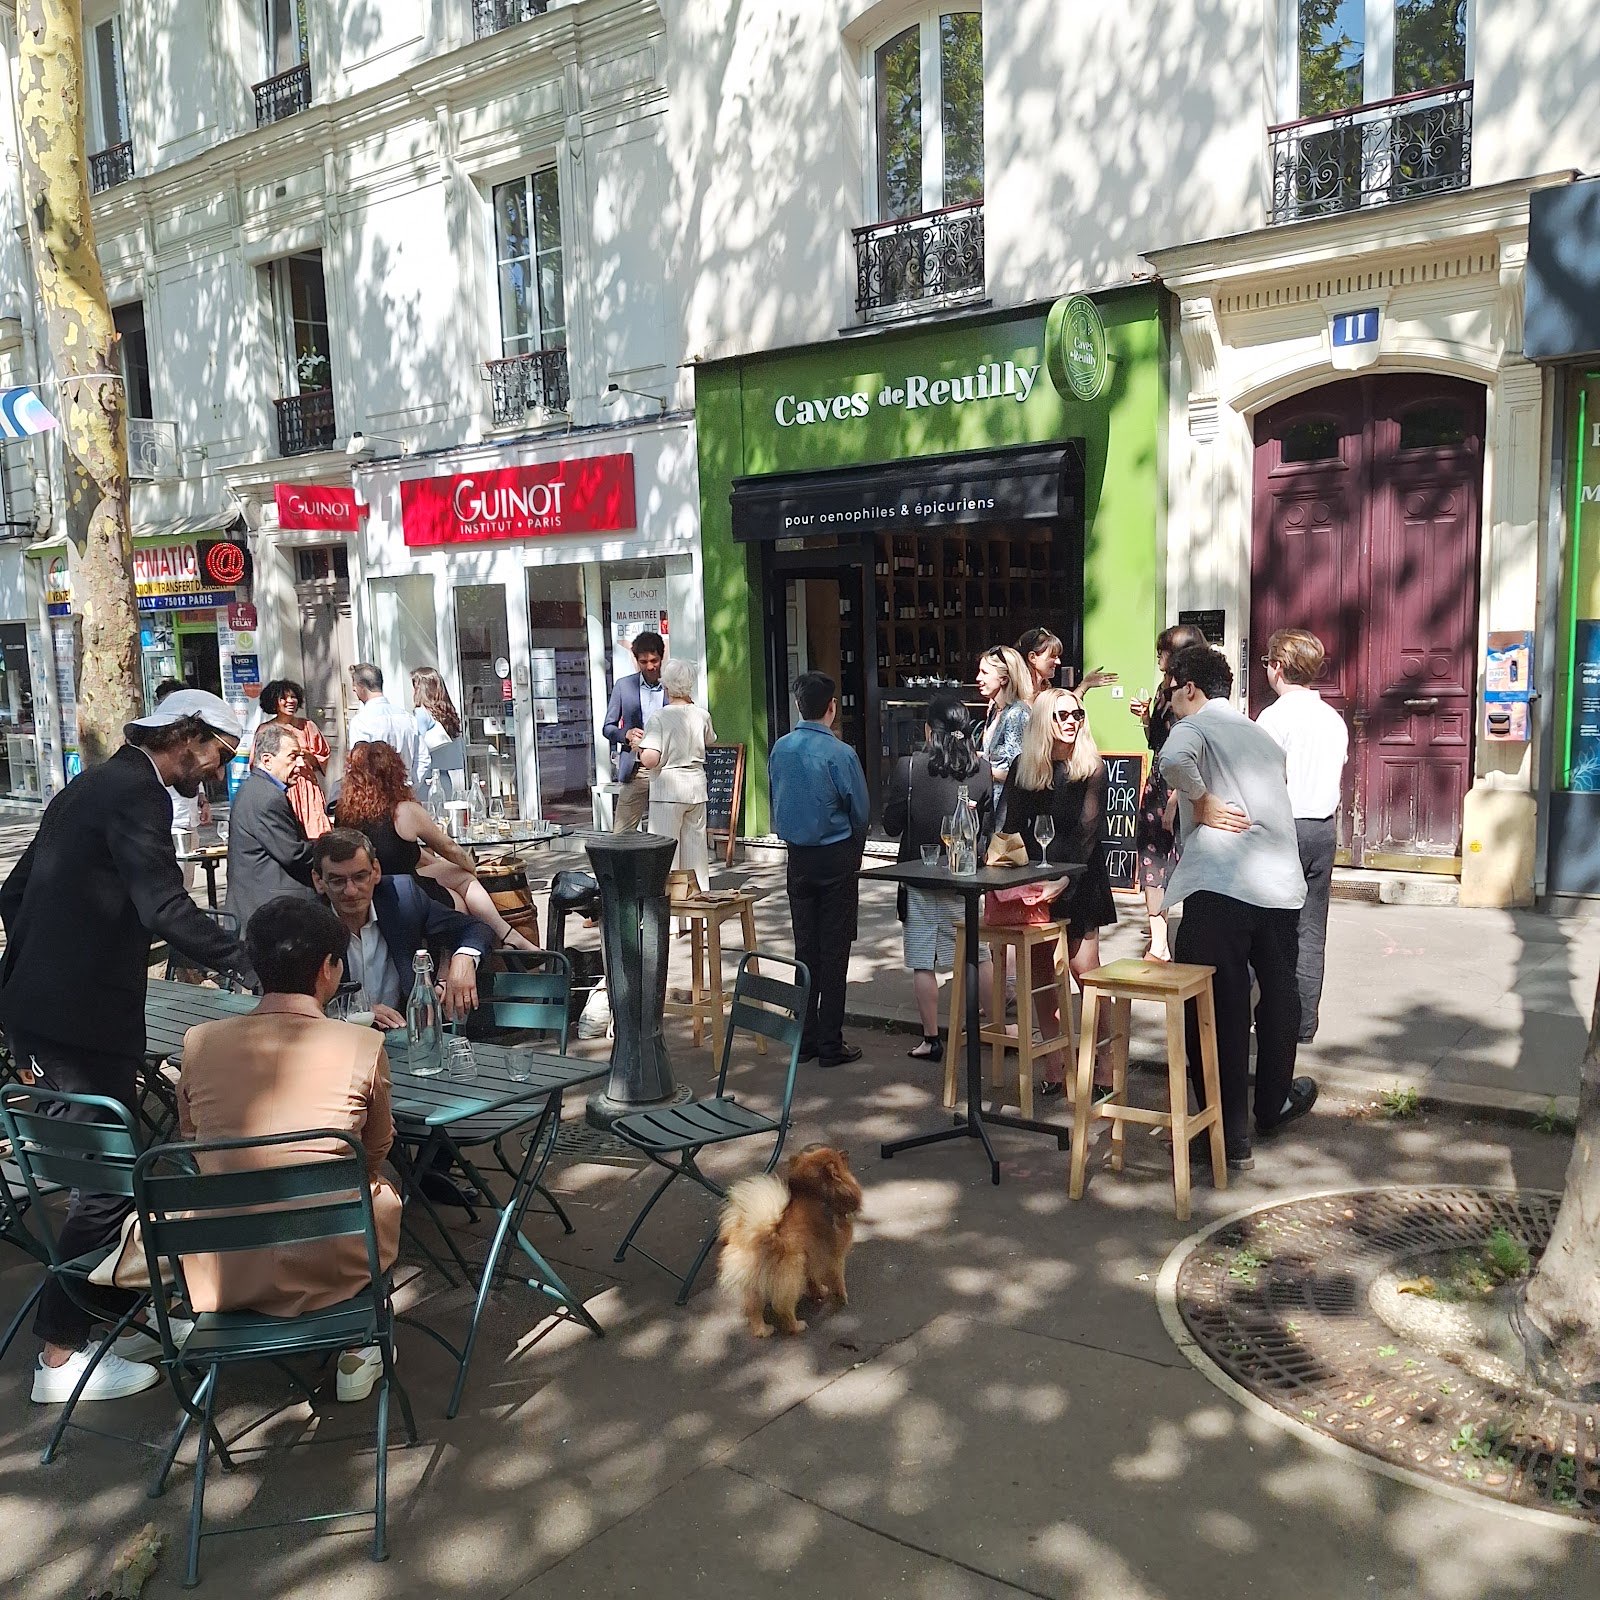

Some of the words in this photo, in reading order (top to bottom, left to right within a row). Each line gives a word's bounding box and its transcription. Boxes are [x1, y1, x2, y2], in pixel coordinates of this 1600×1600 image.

[1344, 313, 1367, 342] 11
[1074, 336, 1093, 352] Caves
[1073, 350, 1096, 368] Reuilly
[774, 390, 870, 427] Caves
[878, 385, 904, 407] de
[904, 360, 1041, 410] Reuilly
[288, 495, 350, 516] GUINOT
[453, 478, 565, 522] GUINOT
[784, 513, 815, 528] pour
[819, 505, 896, 524] oenophiles
[900, 504, 910, 516] &
[914, 497, 995, 520] épicuriens
[460, 520, 513, 535] INSTITUT
[527, 515, 562, 529] PARIS
[157, 580, 194, 594] TRANSFERT
[629, 587, 658, 599] GUINOT
[164, 596, 186, 607] 75012
[189, 594, 213, 605] PARIS
[616, 611, 627, 620] MA
[628, 609, 658, 620] RENTRÉE
[617, 620, 658, 636] BEAUTÉ
[1102, 759, 1129, 783] VE
[1107, 787, 1136, 812] BAR
[1106, 815, 1136, 837] VIN
